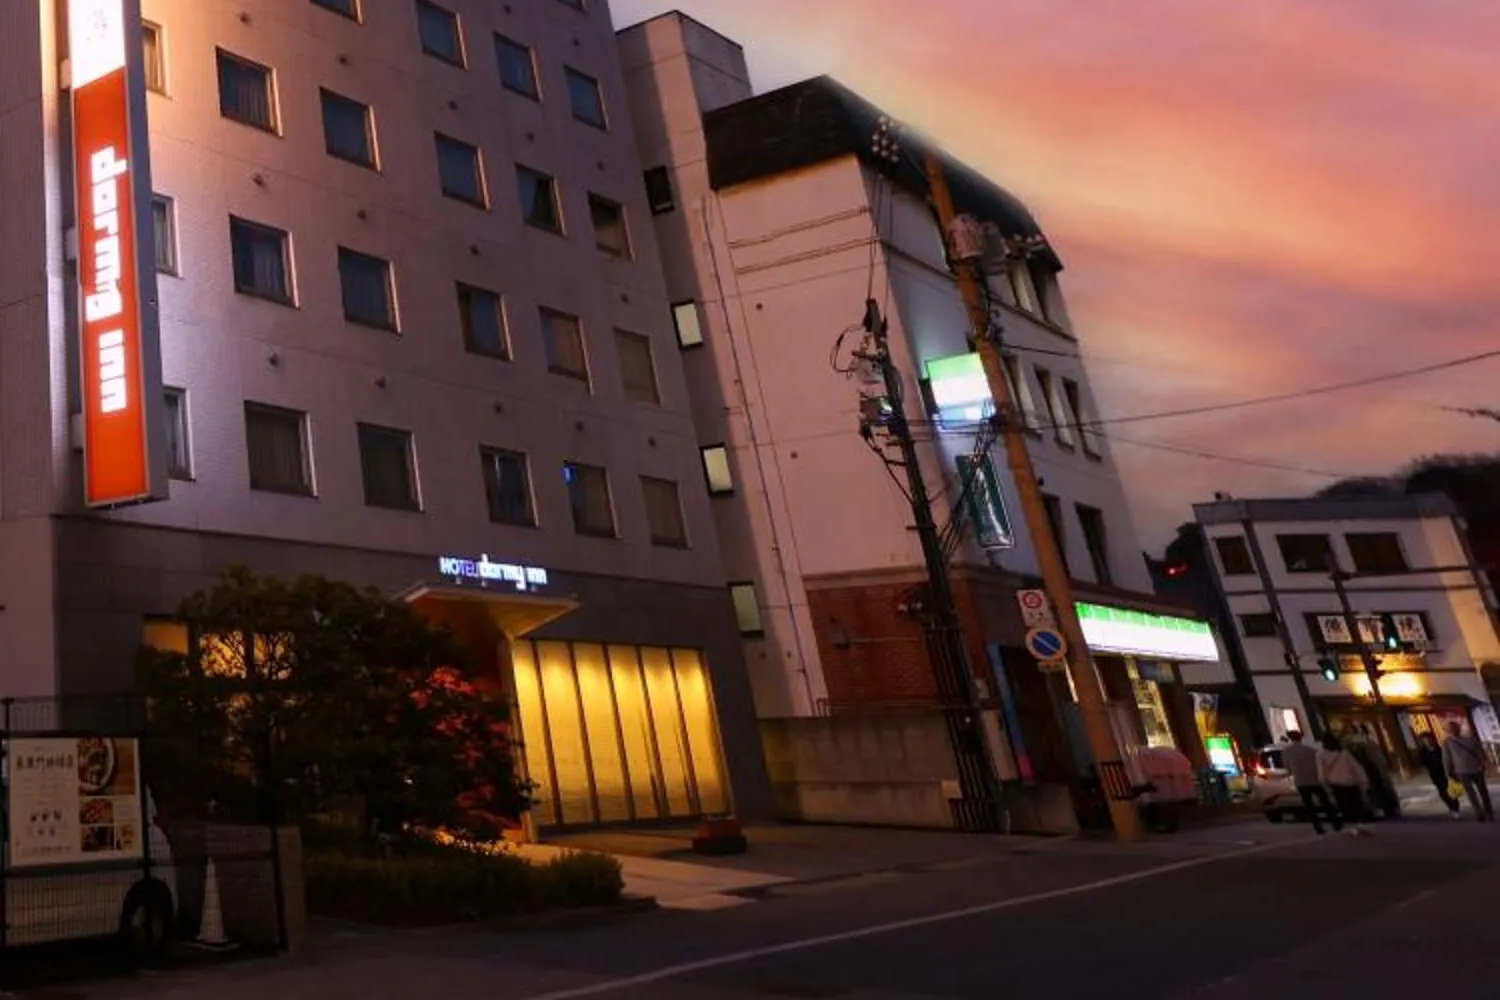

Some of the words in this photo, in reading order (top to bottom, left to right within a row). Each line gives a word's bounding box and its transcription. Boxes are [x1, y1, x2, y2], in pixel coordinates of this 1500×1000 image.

[84, 146, 128, 323] dormy
[98, 328, 128, 413] inn
[438, 555, 478, 578] HOTEL
